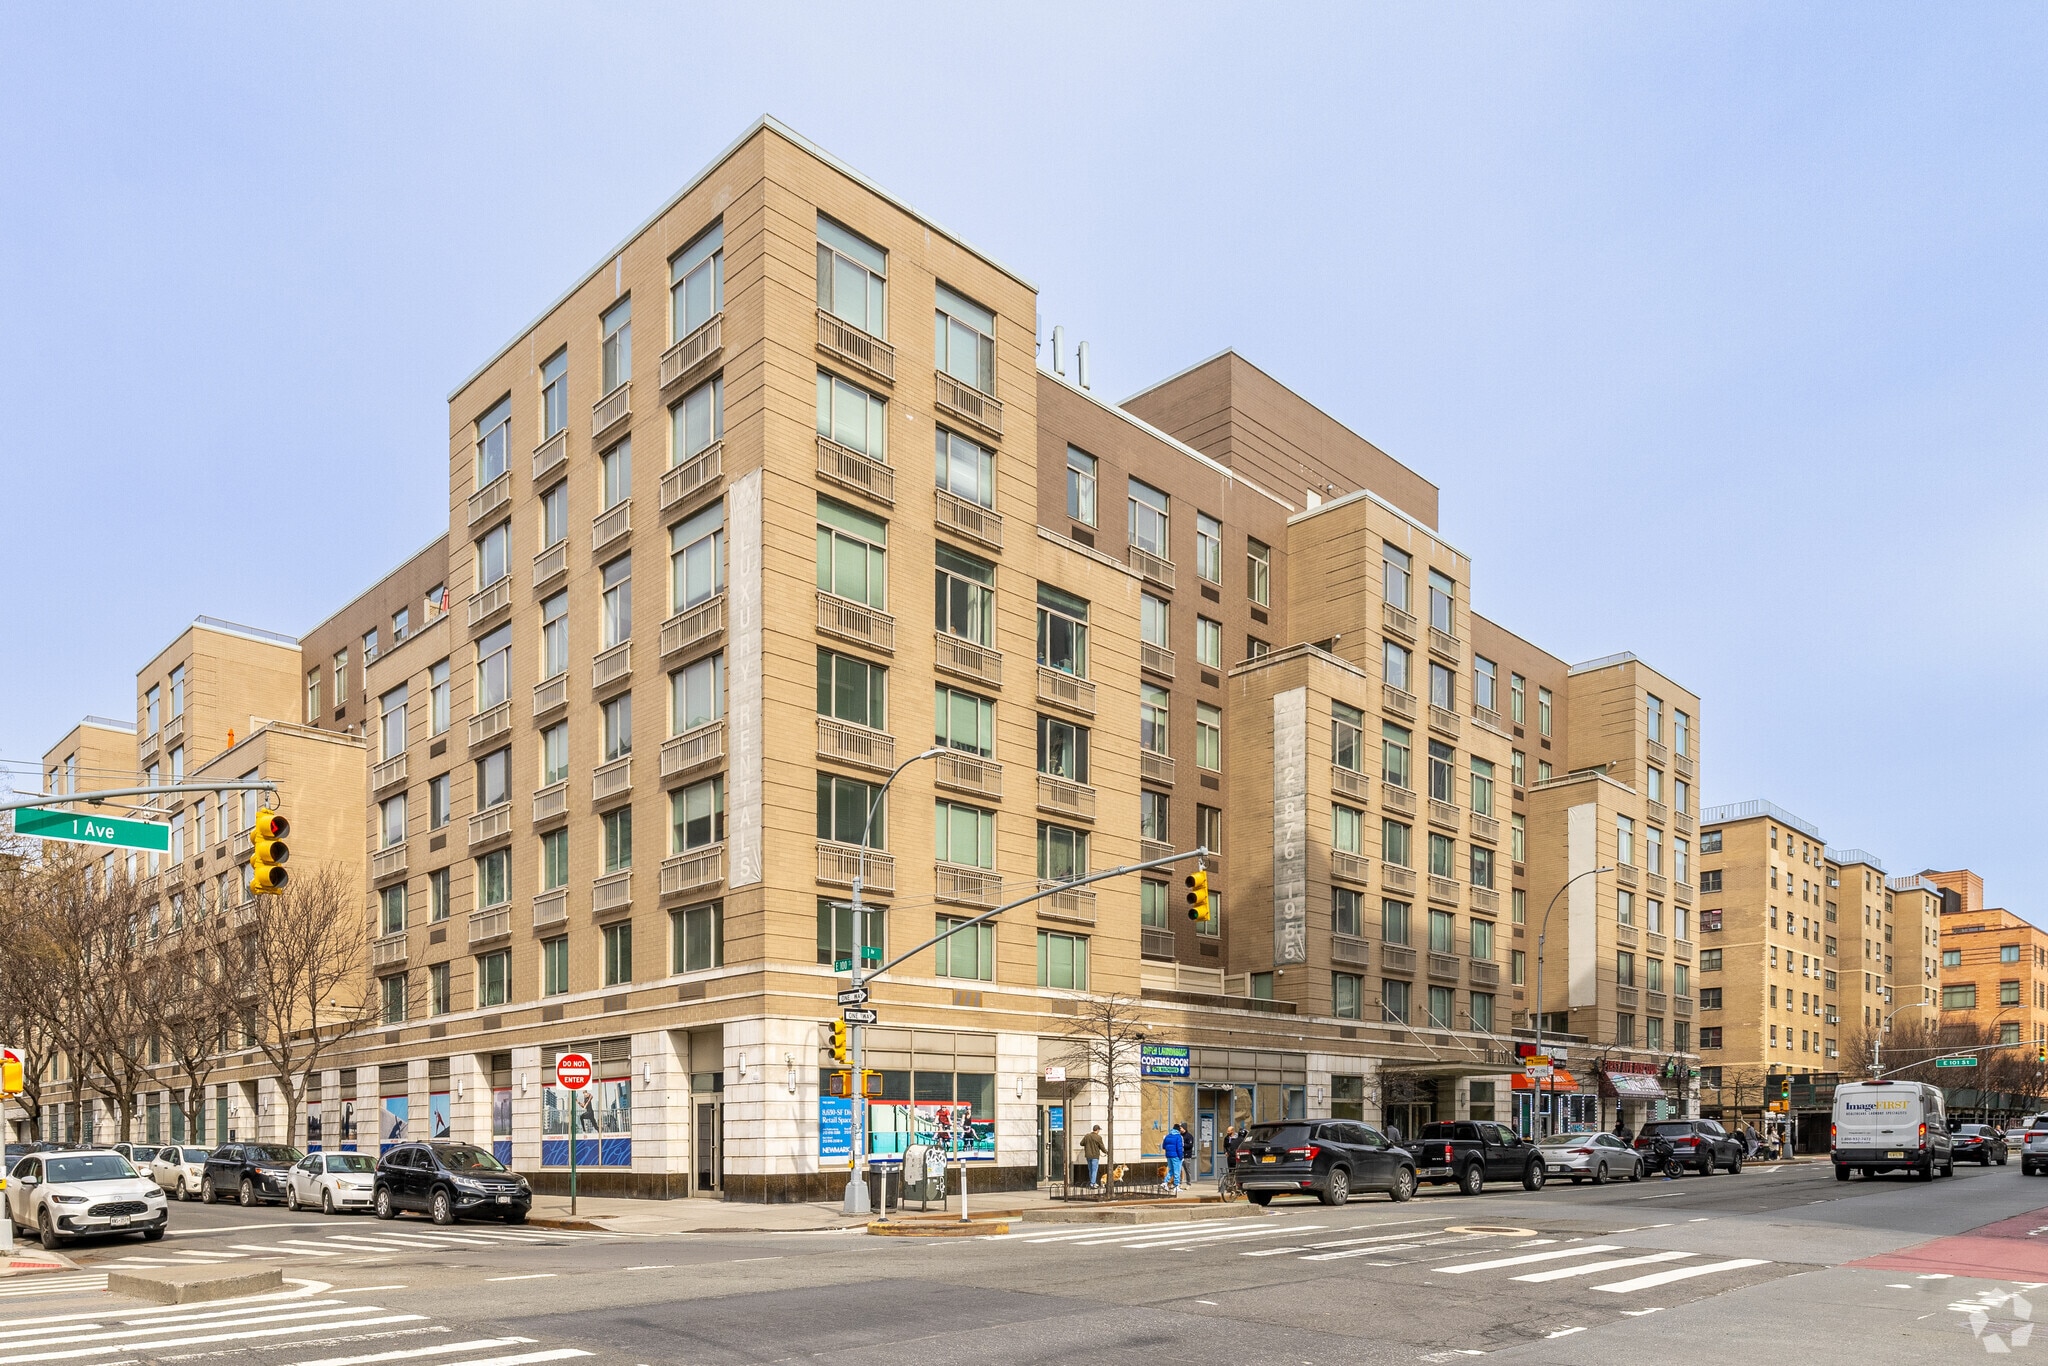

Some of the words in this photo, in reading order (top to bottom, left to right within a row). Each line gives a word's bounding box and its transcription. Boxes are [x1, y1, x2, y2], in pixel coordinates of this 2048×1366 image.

[739, 531, 751, 682] LUXURY
[739, 703, 751, 877] RENTALS
[72, 819, 78, 835] 1
[84, 820, 115, 839] Ave
[835, 961, 839, 972] E
[841, 994, 850, 1002] ONE
[853, 992, 863, 1000] WAY
[848, 1012, 858, 1020] ONE
[562, 1060, 572, 1068] DO
[1141, 1056, 1170, 1066] COMING
[1170, 1057, 1189, 1067] SOON
[564, 1076, 585, 1084] ENTER
[1846, 1101, 1908, 1111] ImageFIRST
[822, 1116, 838, 1124] Retail
[822, 1146, 851, 1154] NEWMARK
